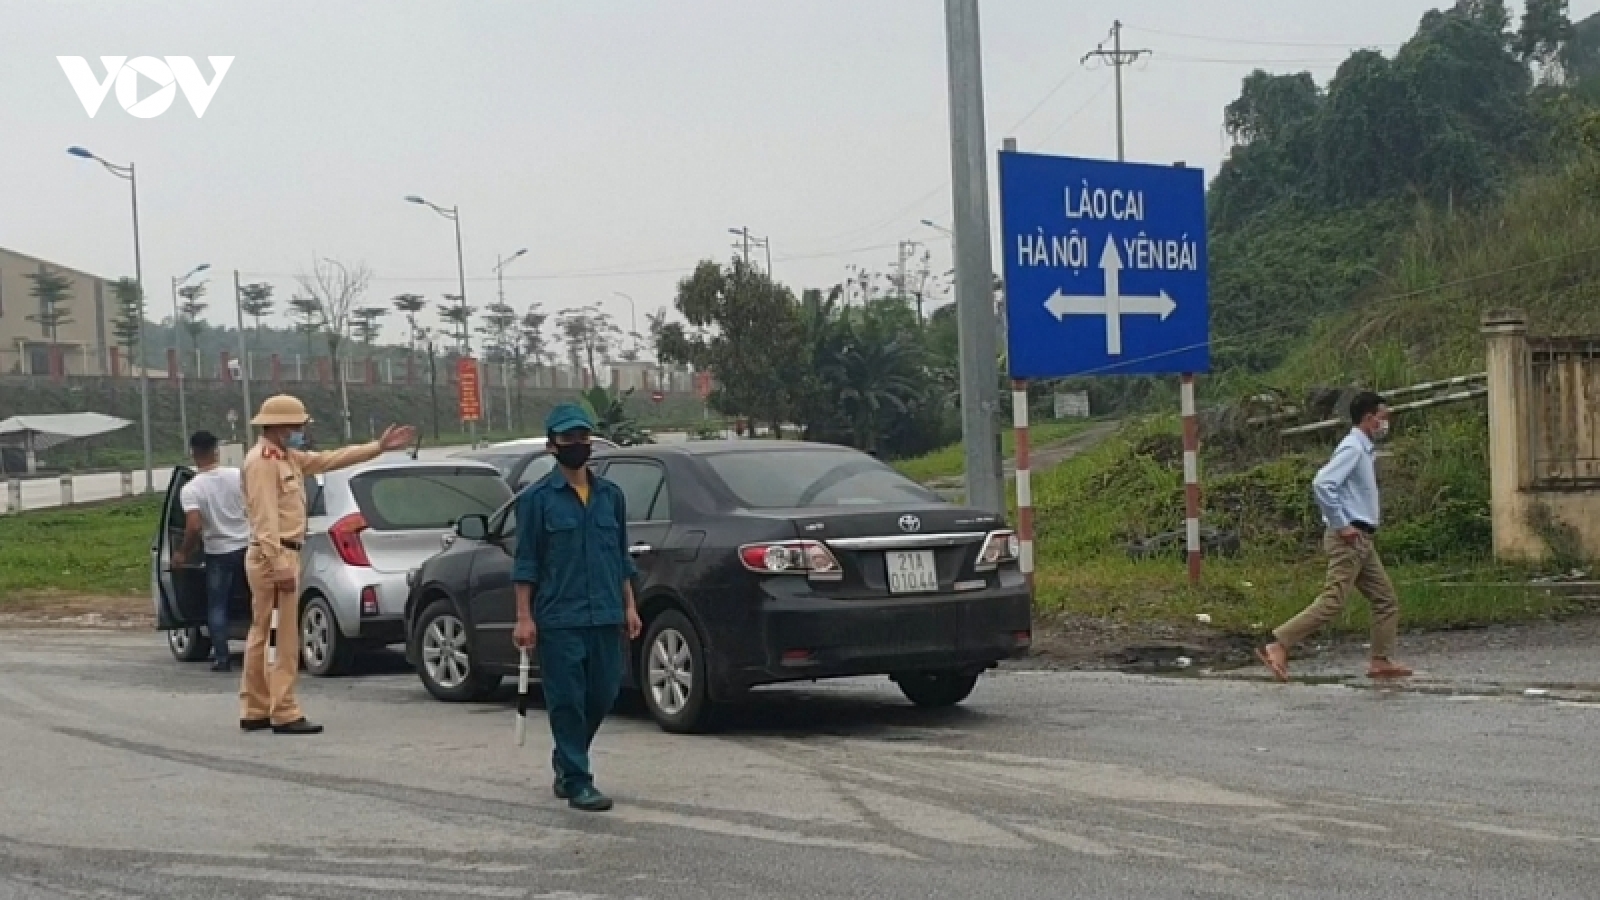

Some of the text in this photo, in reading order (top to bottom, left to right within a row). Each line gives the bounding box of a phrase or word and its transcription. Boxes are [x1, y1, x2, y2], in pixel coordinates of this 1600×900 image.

[1064, 178, 1144, 221] LÀO CAI
[1017, 226, 1088, 276] HÀ NỘI
[1123, 231, 1197, 271] YÊN BÁI
[897, 553, 925, 571] 21A
